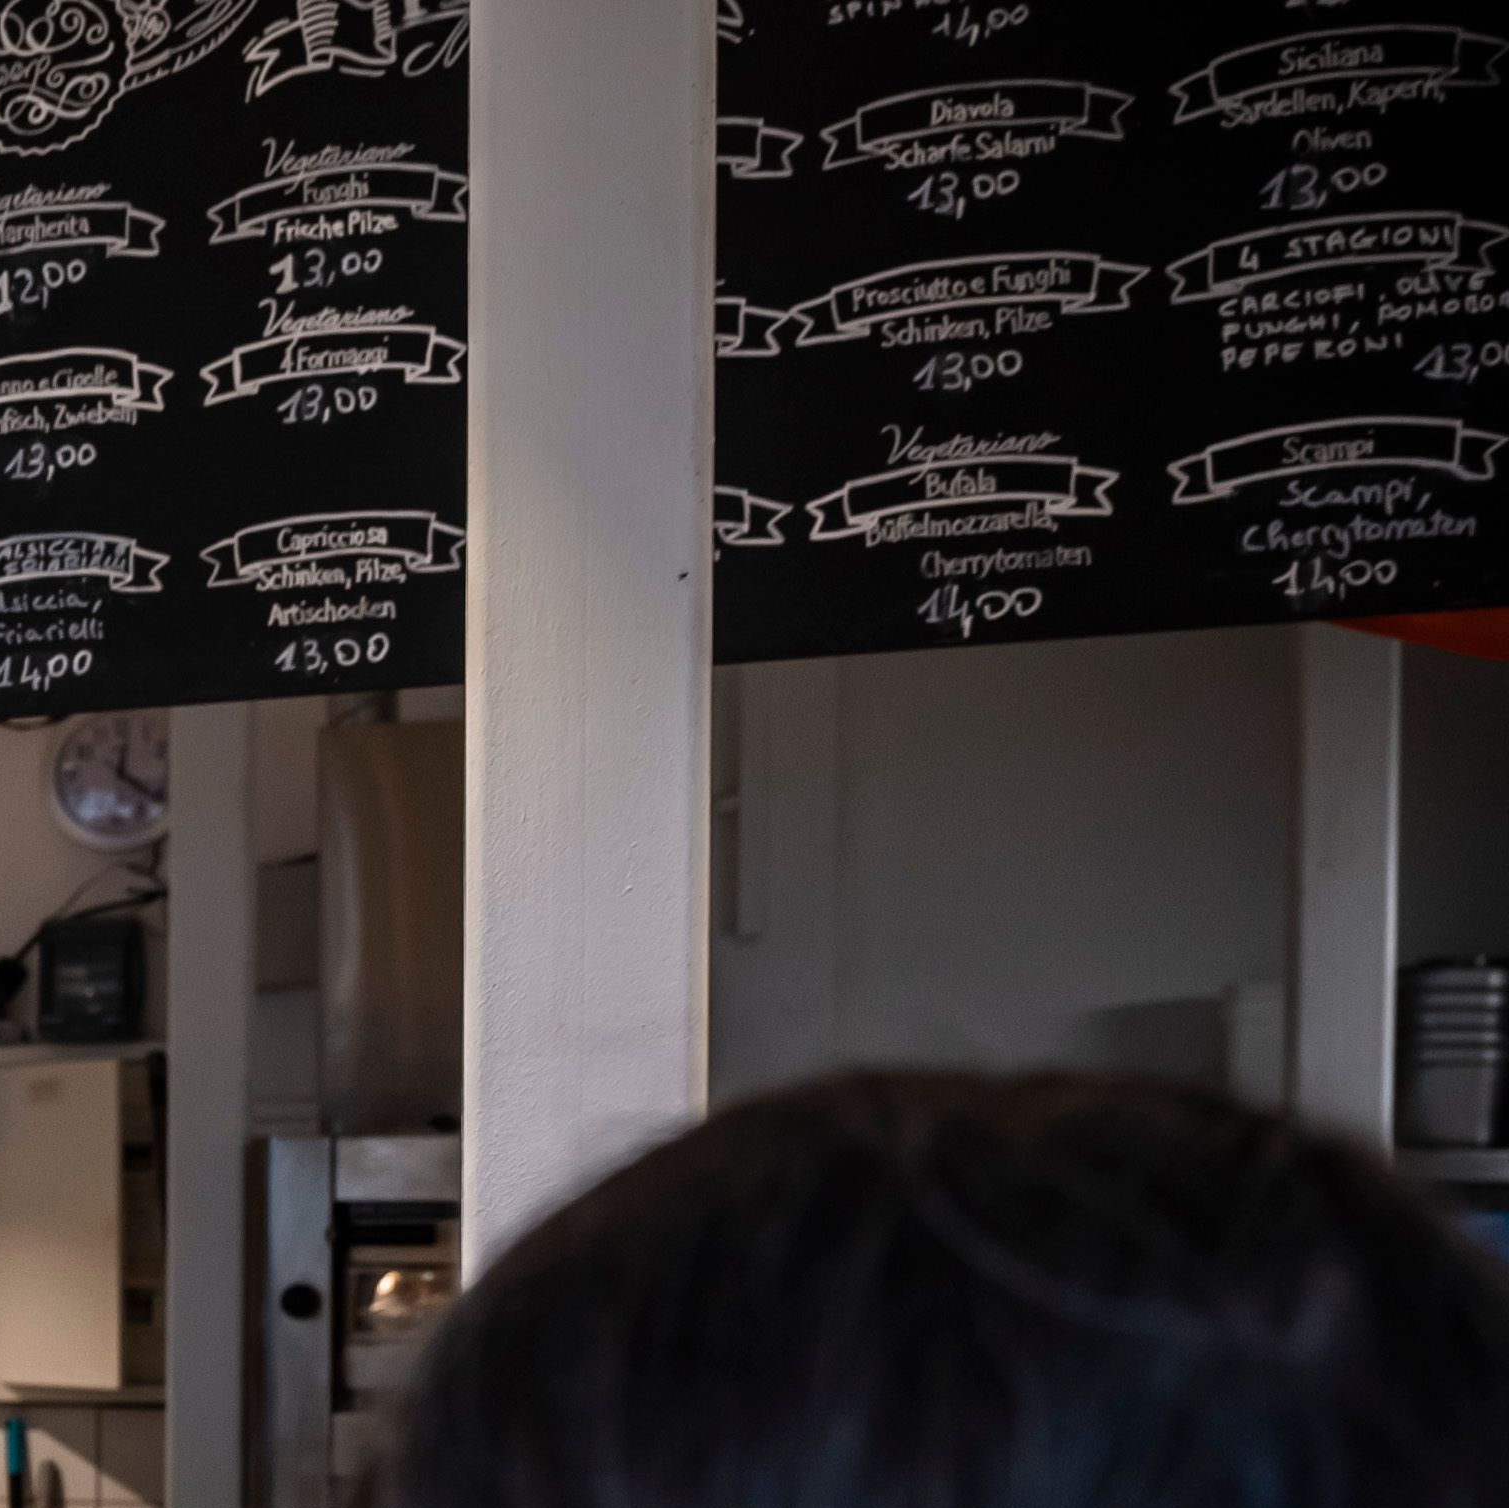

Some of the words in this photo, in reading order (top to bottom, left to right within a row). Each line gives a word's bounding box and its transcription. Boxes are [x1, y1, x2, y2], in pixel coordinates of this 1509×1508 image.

[1278, 42, 1385, 75] Siciliana
[930, 93, 1015, 126] Diavola
[884, 137, 972, 170] Scharfe
[974, 124, 1056, 160] Salami
[1291, 126, 1373, 153] Oliven
[262, 138, 415, 194] Vegetariano
[301, 171, 370, 205] Funghi
[907, 170, 1021, 220] 13,00
[1258, 162, 1388, 211] 13,00
[346, 212, 399, 239] Pilze
[1238, 246, 1260, 271] 4
[1283, 226, 1453, 259] STAGIONI
[269, 248, 383, 295] 13,00
[852, 273, 967, 312] Prosciutto
[991, 259, 1072, 295] Funghi
[259, 297, 414, 345] Vegetariano
[880, 311, 990, 349] Schinken,
[995, 306, 1053, 337] Pilze
[297, 337, 389, 377] Formaggi
[912, 349, 1023, 392] 13,00
[1413, 342, 1509, 384] 13,0
[53, 366, 118, 397] Cipolle
[277, 387, 379, 425] 13,00
[4, 443, 97, 481] 13,00
[881, 424, 1061, 484] Vegetariano
[1281, 428, 1376, 466] Scampi
[924, 468, 998, 499] Bufala
[1279, 476, 1431, 516] Scampi,
[277, 522, 389, 556] Capricciosa
[1241, 512, 1477, 559] Cherrytomaten
[256, 563, 352, 593] Schinken,
[920, 544, 1092, 580] Cherrytomaten
[268, 597, 396, 628] Artischocken
[917, 583, 1043, 640] 14,00
[274, 632, 391, 675] 13,00
